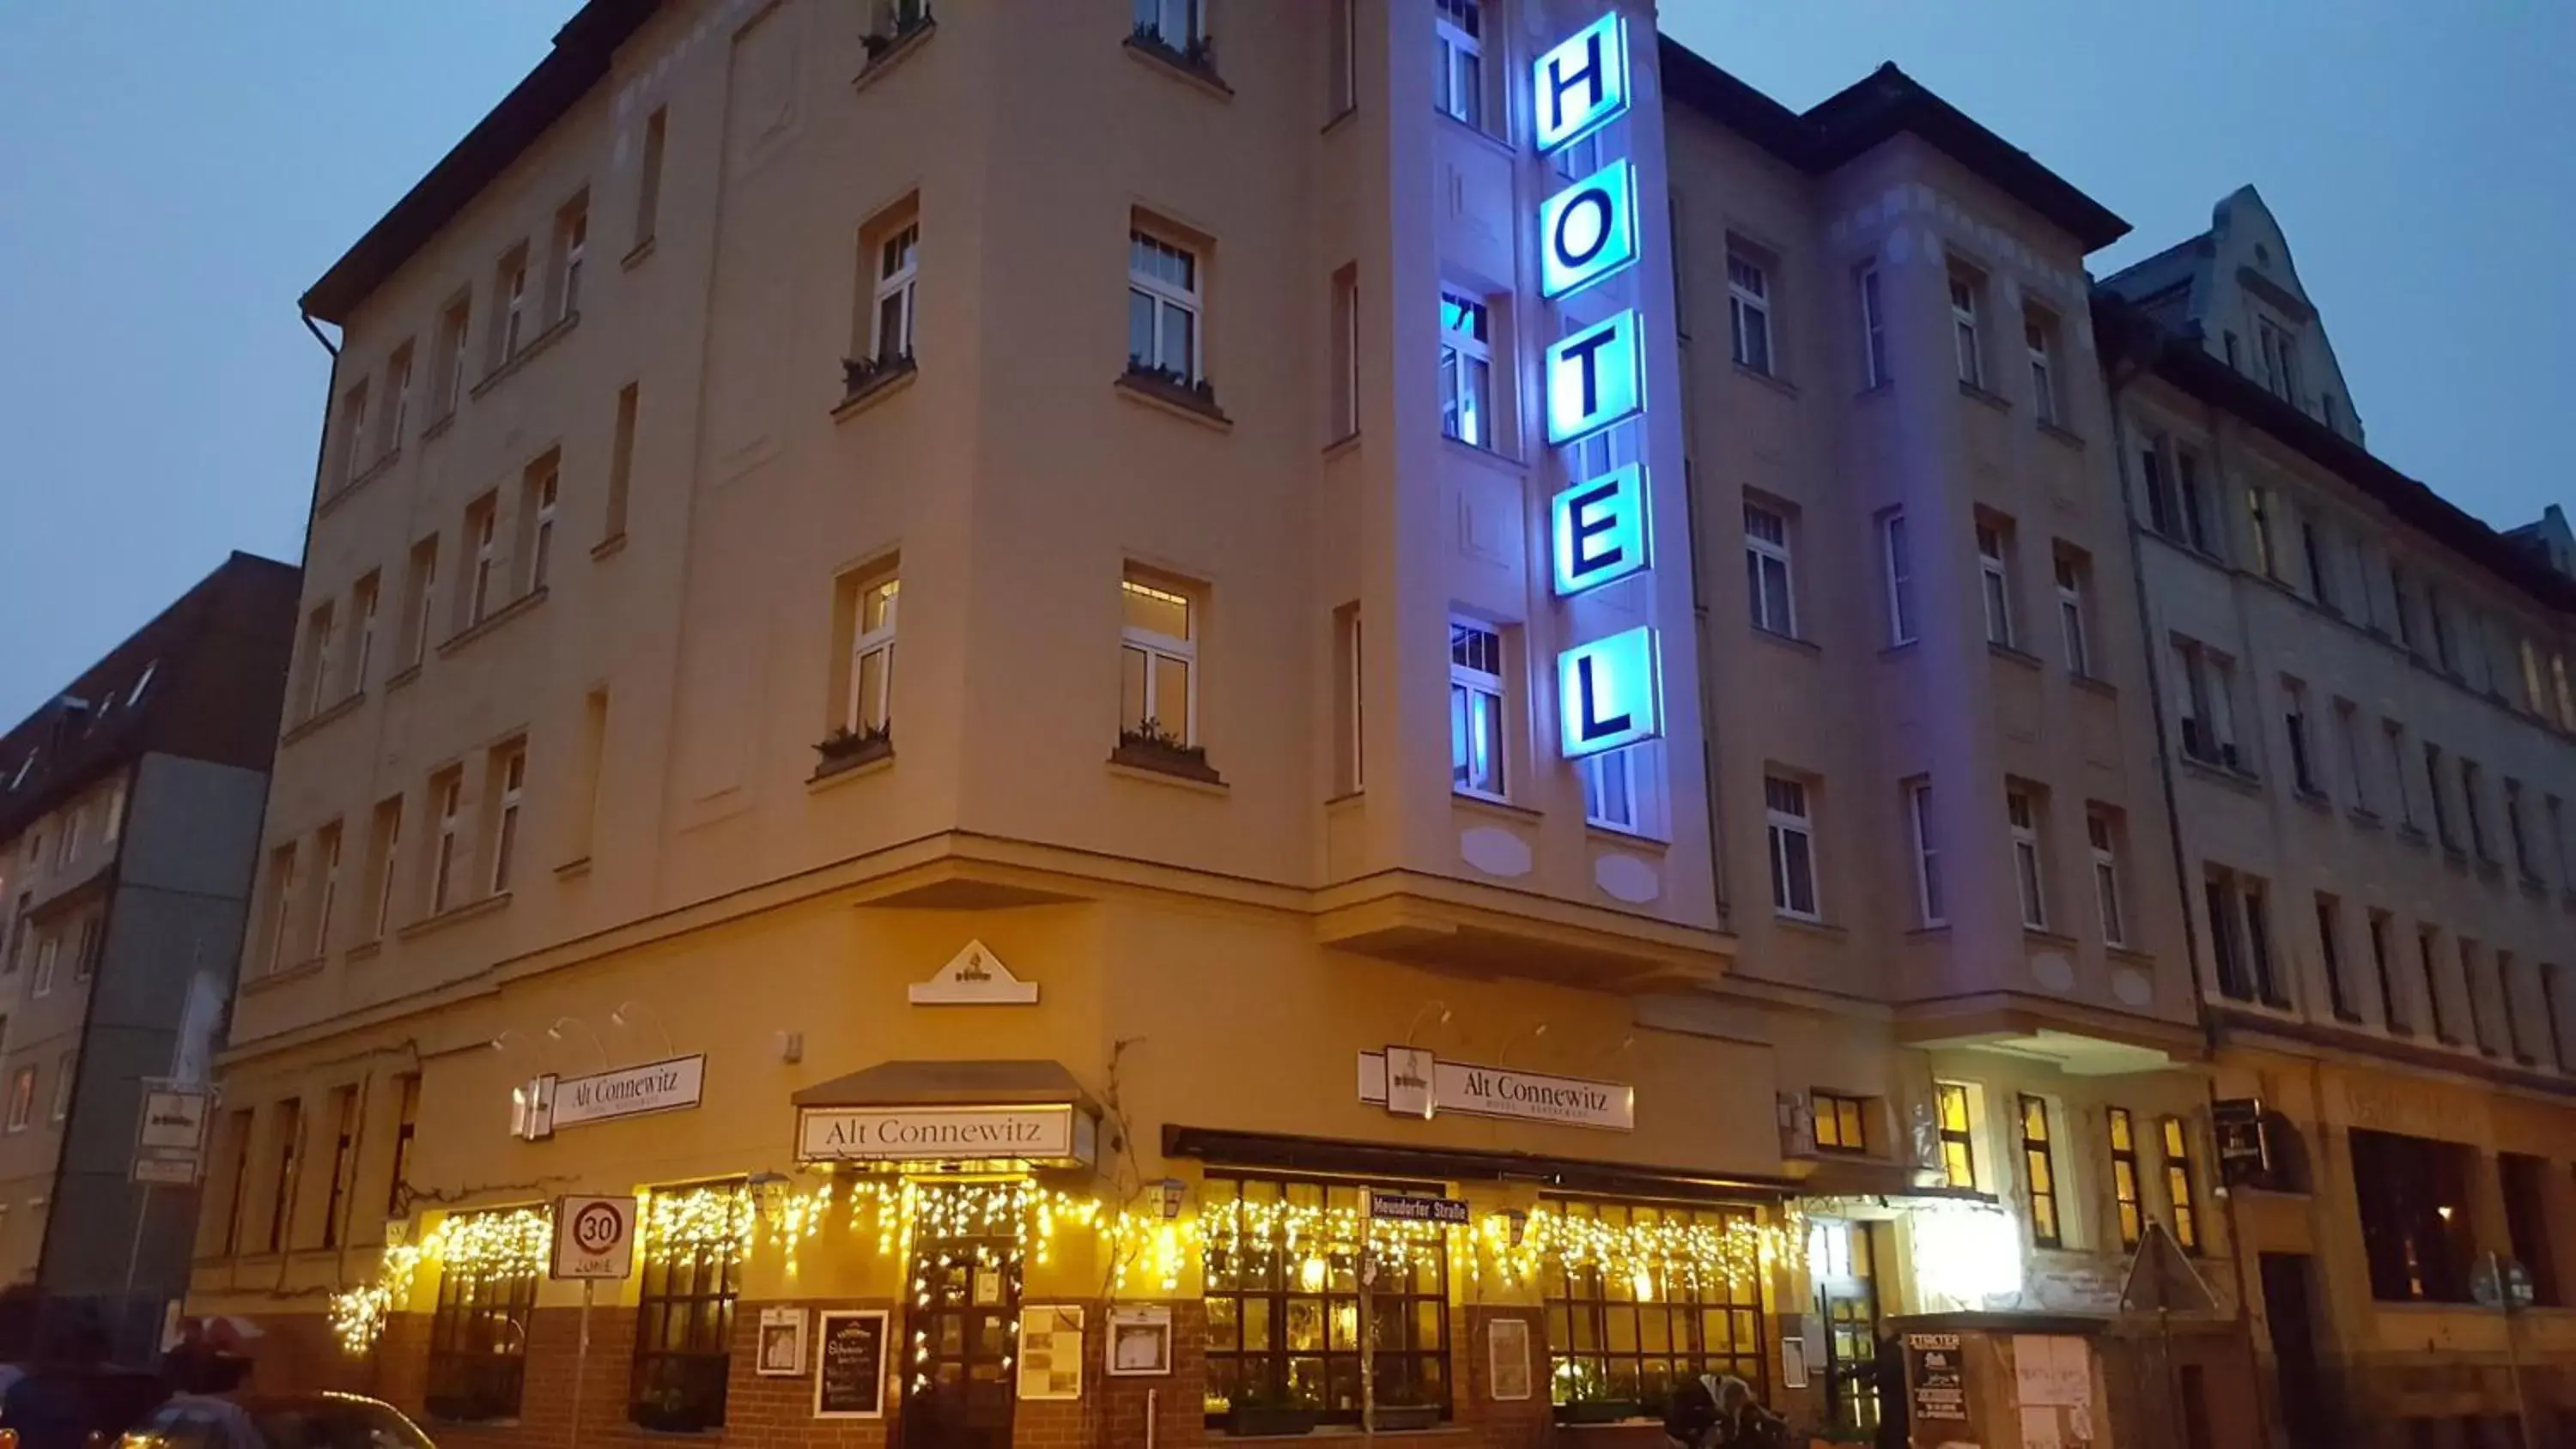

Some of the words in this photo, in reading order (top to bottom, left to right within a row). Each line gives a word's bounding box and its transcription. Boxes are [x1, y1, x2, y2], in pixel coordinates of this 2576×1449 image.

[1549, 31, 1631, 742] HOTEL
[574, 1082, 591, 1107] Alt
[595, 1068, 678, 1103] Connewitz
[1463, 1070, 1492, 1098] Alt
[1498, 1076, 1609, 1112] Connewitz
[825, 1119, 866, 1144] Alt
[878, 1117, 1042, 1144] Connewitz
[1433, 1201, 1466, 1221] Straße
[584, 1216, 612, 1241] 30
